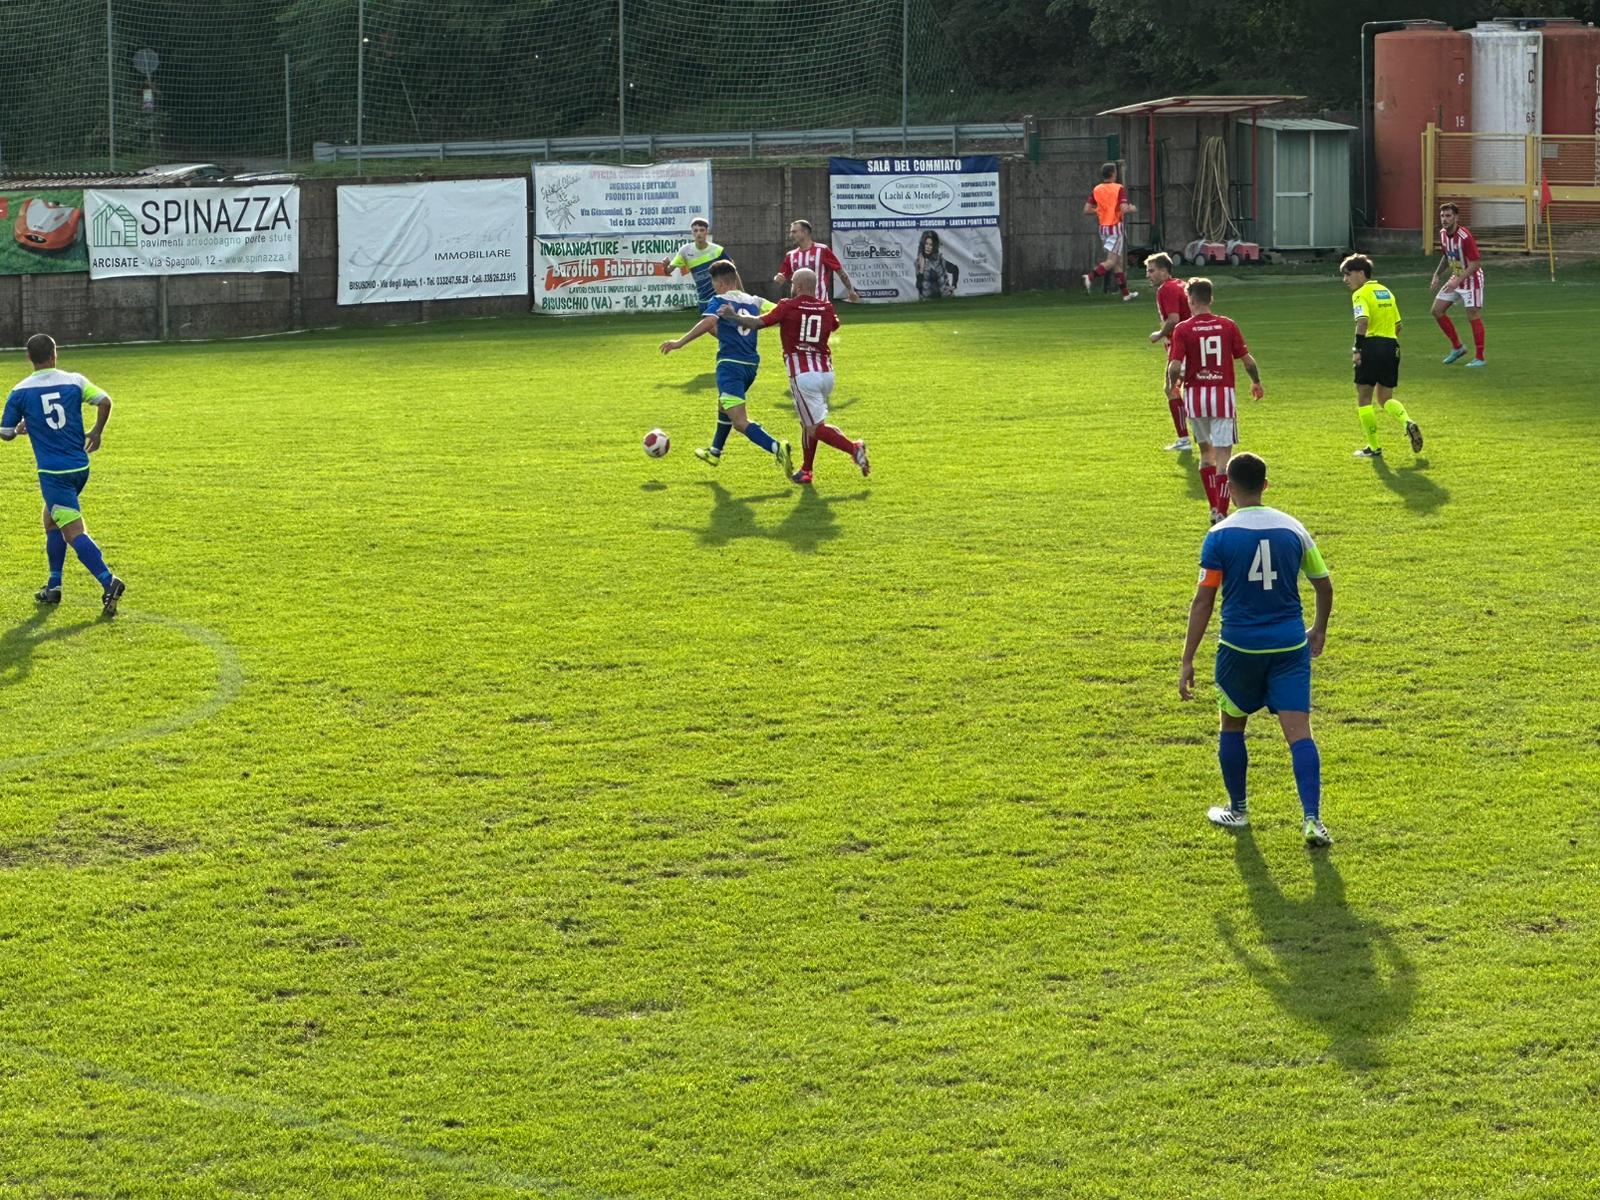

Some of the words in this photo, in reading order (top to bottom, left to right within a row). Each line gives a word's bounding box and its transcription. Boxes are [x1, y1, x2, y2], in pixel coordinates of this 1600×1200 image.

[1455, 115, 1465, 128] 19
[867, 160, 890, 173] SALA
[894, 159, 911, 172] DEL
[913, 159, 962, 171] COMMIATO
[605, 192, 636, 201] PRODOTTI
[884, 191, 903, 200] Lachi
[141, 196, 291, 235] SPINAZZA
[580, 207, 590, 217] Via
[624, 207, 633, 216] 15
[624, 217, 636, 226] Fax
[140, 237, 183, 250] pavimenti
[244, 234, 266, 245] porte
[540, 240, 619, 257] IMBIANCATURE
[92, 257, 139, 268] ARCISATE
[149, 256, 163, 267] Via
[205, 254, 217, 265] 12
[434, 249, 511, 261] IMMOBILIARE
[604, 259, 654, 276] Fabrizio
[542, 296, 589, 310] BISUSCHIO
[591, 295, 613, 310] (VA)
[623, 295, 638, 309] Tel.
[799, 313, 822, 343] 10
[1199, 335, 1222, 367] 19
[40, 391, 67, 430] 5
[1248, 539, 1277, 590] 4
